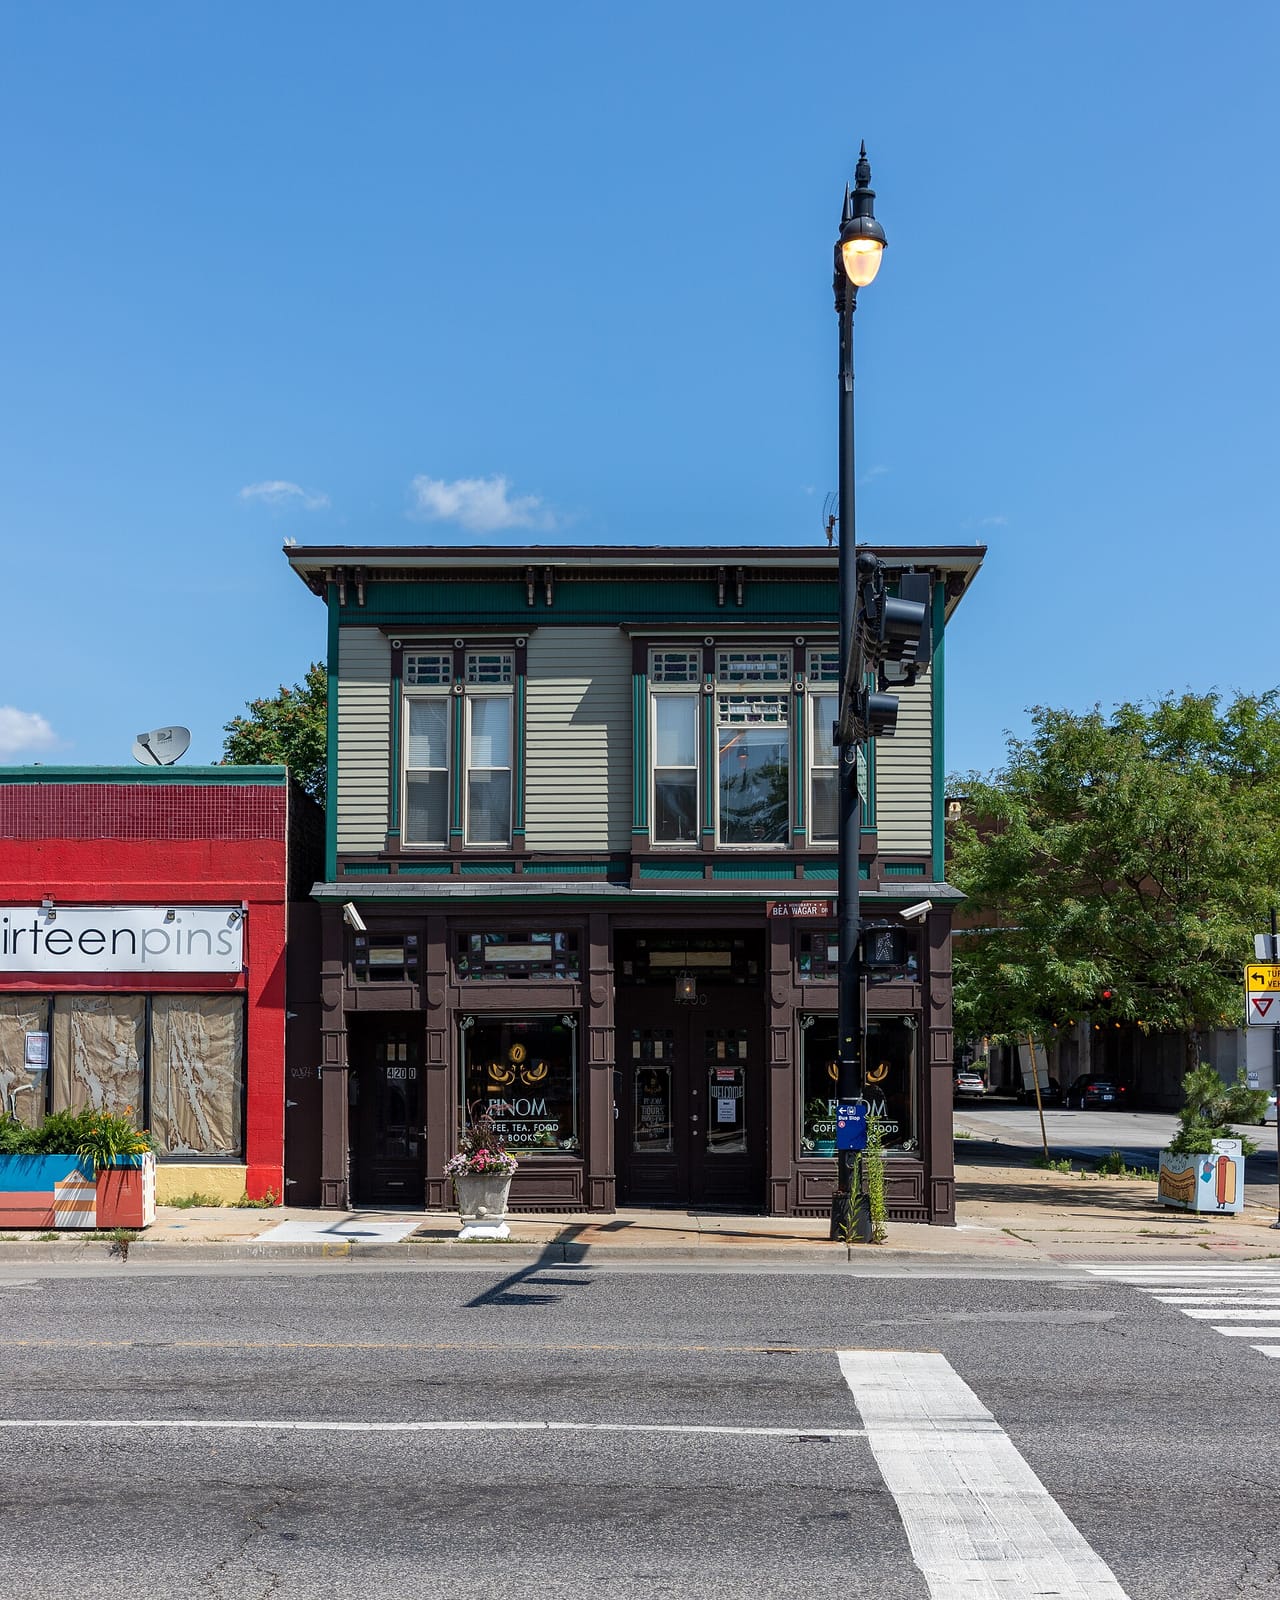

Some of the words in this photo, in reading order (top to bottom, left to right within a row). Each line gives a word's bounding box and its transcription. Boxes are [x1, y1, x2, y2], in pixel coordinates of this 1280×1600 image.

[773, 907, 788, 915] BEA
[792, 907, 817, 915] WAGAR
[3, 917, 233, 963] irteenpins
[711, 1086, 744, 1098] WELCOME
[489, 1098, 548, 1116] FINOM
[533, 1123, 559, 1132] FOOD
[813, 1124, 836, 1132] COFF
[873, 1124, 898, 1133] FOOD
[499, 1134, 504, 1142] &
[507, 1134, 537, 1142] BOOKS
